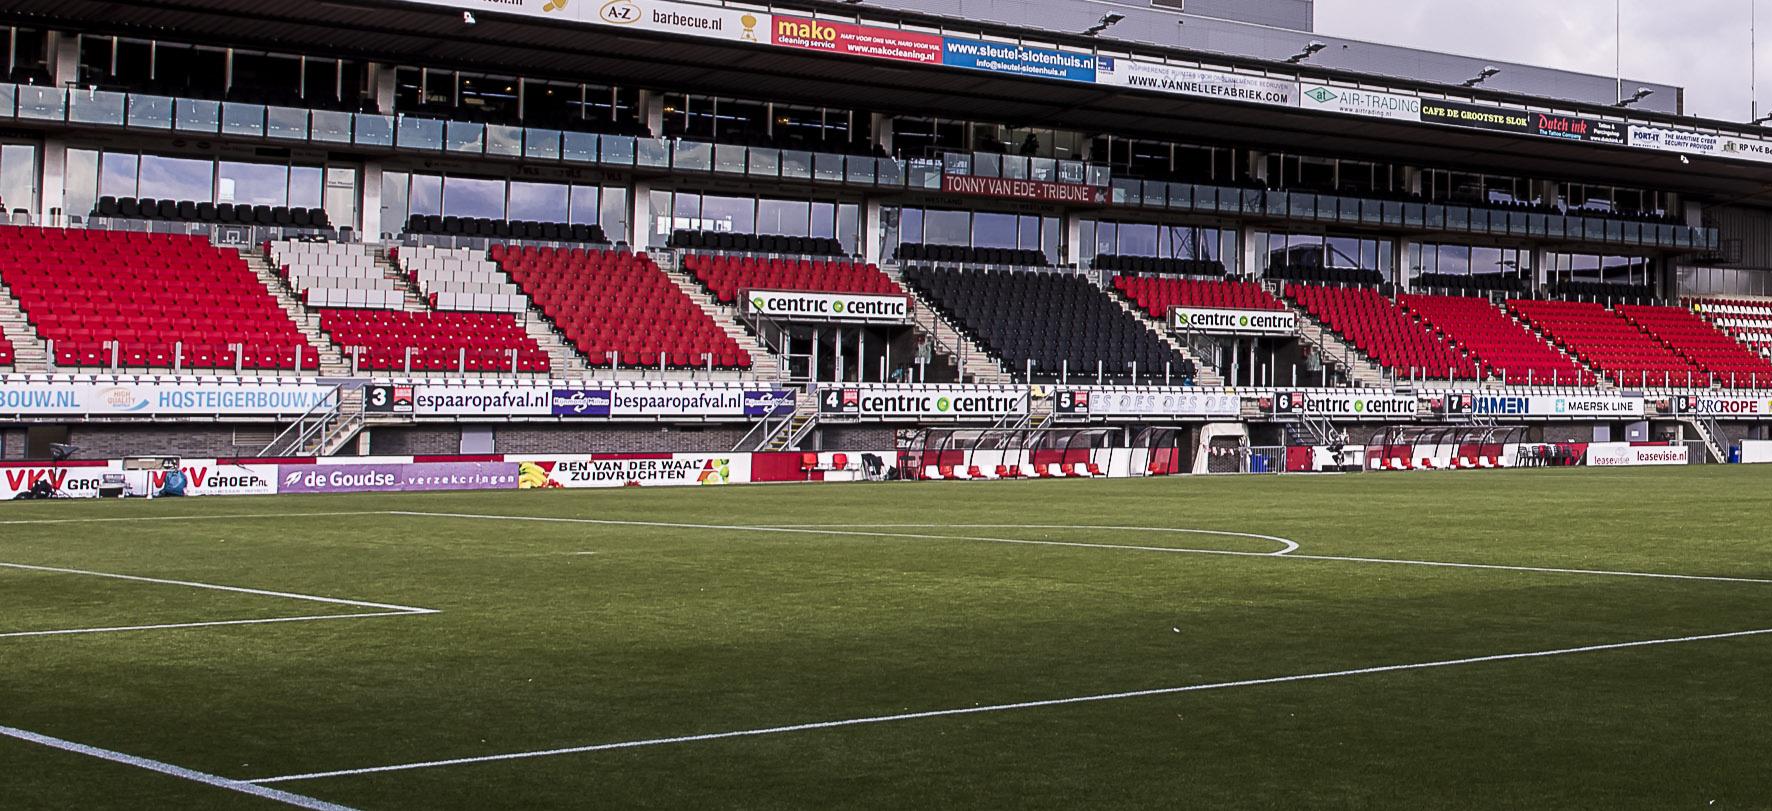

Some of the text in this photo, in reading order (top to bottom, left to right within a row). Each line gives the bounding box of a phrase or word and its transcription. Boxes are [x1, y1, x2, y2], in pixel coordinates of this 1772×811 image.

[608, 7, 631, 19] A-Z
[653, 9, 722, 31] barbecue.nl
[778, 20, 836, 40] mako
[778, 37, 836, 49] cleaning service
[848, 43, 934, 61] www.makocleaning.nl
[947, 42, 1094, 71] www.sleutel-slotenhuis.nl
[1128, 75, 1288, 103] WWW.VANNELLEFABRIEK.COM
[1339, 92, 1419, 113] AIR-TRADING
[1422, 106, 1527, 128] CAFE DE GROOTSTE SLOK
[1538, 114, 1587, 135] Dutch ink
[1633, 131, 1660, 142] PORT-IT
[1664, 133, 1717, 145] THE MARITIME CYBER
[1664, 139, 1714, 151] SECURITY PROVIDER
[1739, 143, 1748, 152] RP
[1749, 145, 1763, 153] VvE
[946, 176, 1089, 201] TONNY VAN EDE TRIBUNE
[768, 298, 904, 315] centric centric
[1190, 312, 1293, 328] centric centric
[372, 388, 386, 406] 3
[614, 392, 741, 412] bespaaropafval.nl
[826, 393, 838, 407] 4
[861, 394, 1018, 412] centric centric
[1060, 394, 1071, 408] 5
[1279, 394, 1289, 407] 6
[1451, 396, 1459, 408] 7
[1473, 396, 1529, 413] DAMEN
[1679, 396, 1686, 409] 8
[1366, 398, 1415, 413] centric
[1568, 401, 1633, 411] MAERSK LINE
[1594, 450, 1687, 465] leasevisie leasevisie.nl
[558, 460, 698, 472] BEN VAN DER WAAL
[6, 469, 67, 492] VKV
[304, 471, 514, 487] de Goudse verzekeringen
[570, 469, 685, 481] ZUIDVRUCHTEN
